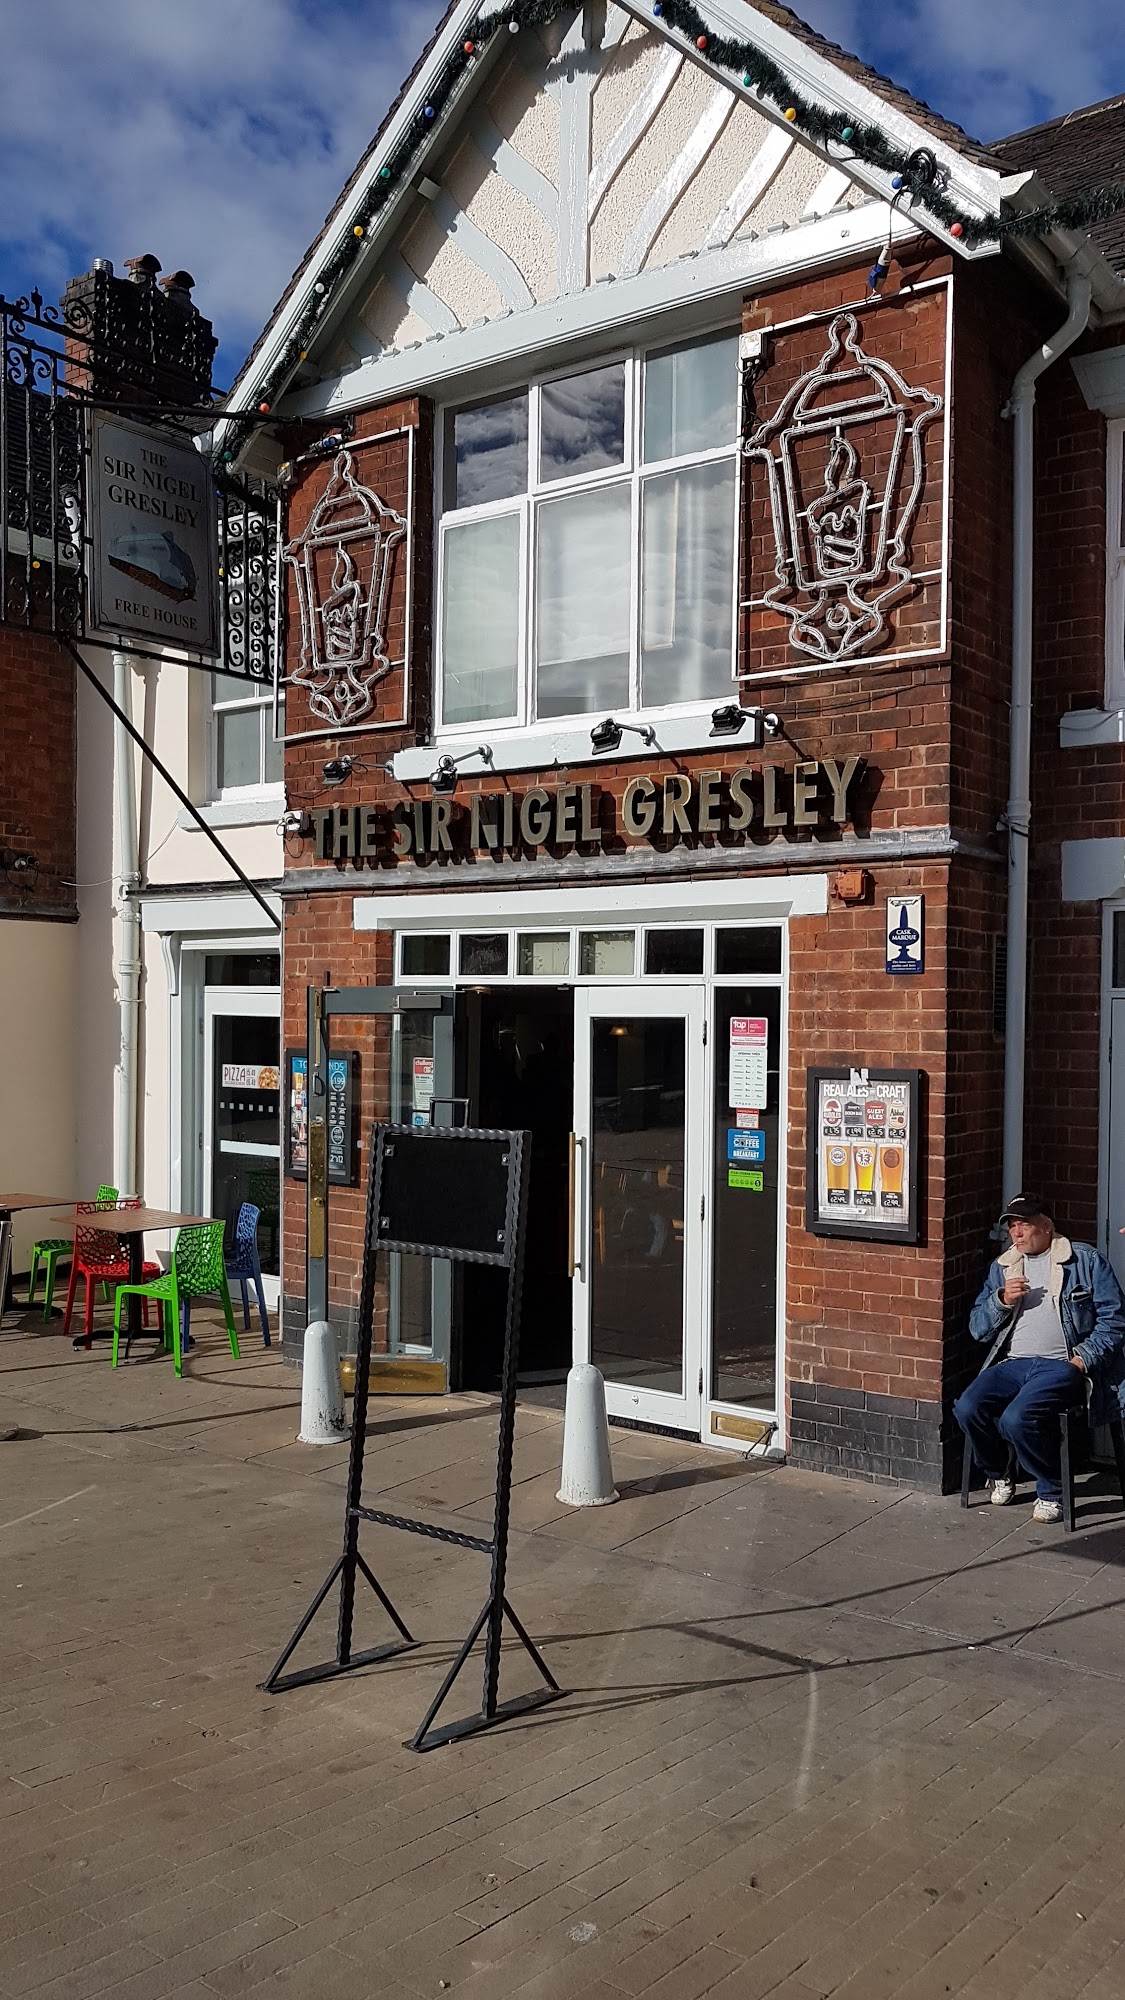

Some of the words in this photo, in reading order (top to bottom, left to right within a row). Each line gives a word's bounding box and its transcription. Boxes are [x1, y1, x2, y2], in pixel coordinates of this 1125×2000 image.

[140, 448, 168, 469] THE
[103, 455, 137, 482] SIR
[142, 468, 202, 504] NIGEL
[107, 483, 200, 529] GRESLEY
[114, 597, 150, 619] FREE
[153, 604, 198, 631] HOUSE
[311, 806, 378, 860] THE
[392, 798, 454, 856] SIR
[470, 784, 602, 850] NIGEL
[621, 756, 865, 838] GRESLEY
[224, 1066, 246, 1081] PIZZA
[823, 1083, 846, 1097] REAL
[846, 1084, 870, 1098] ALES
[876, 1084, 907, 1099] CRAFT
[732, 1149, 760, 1159] BREAKFAST
[857, 1153, 872, 1163] 13
